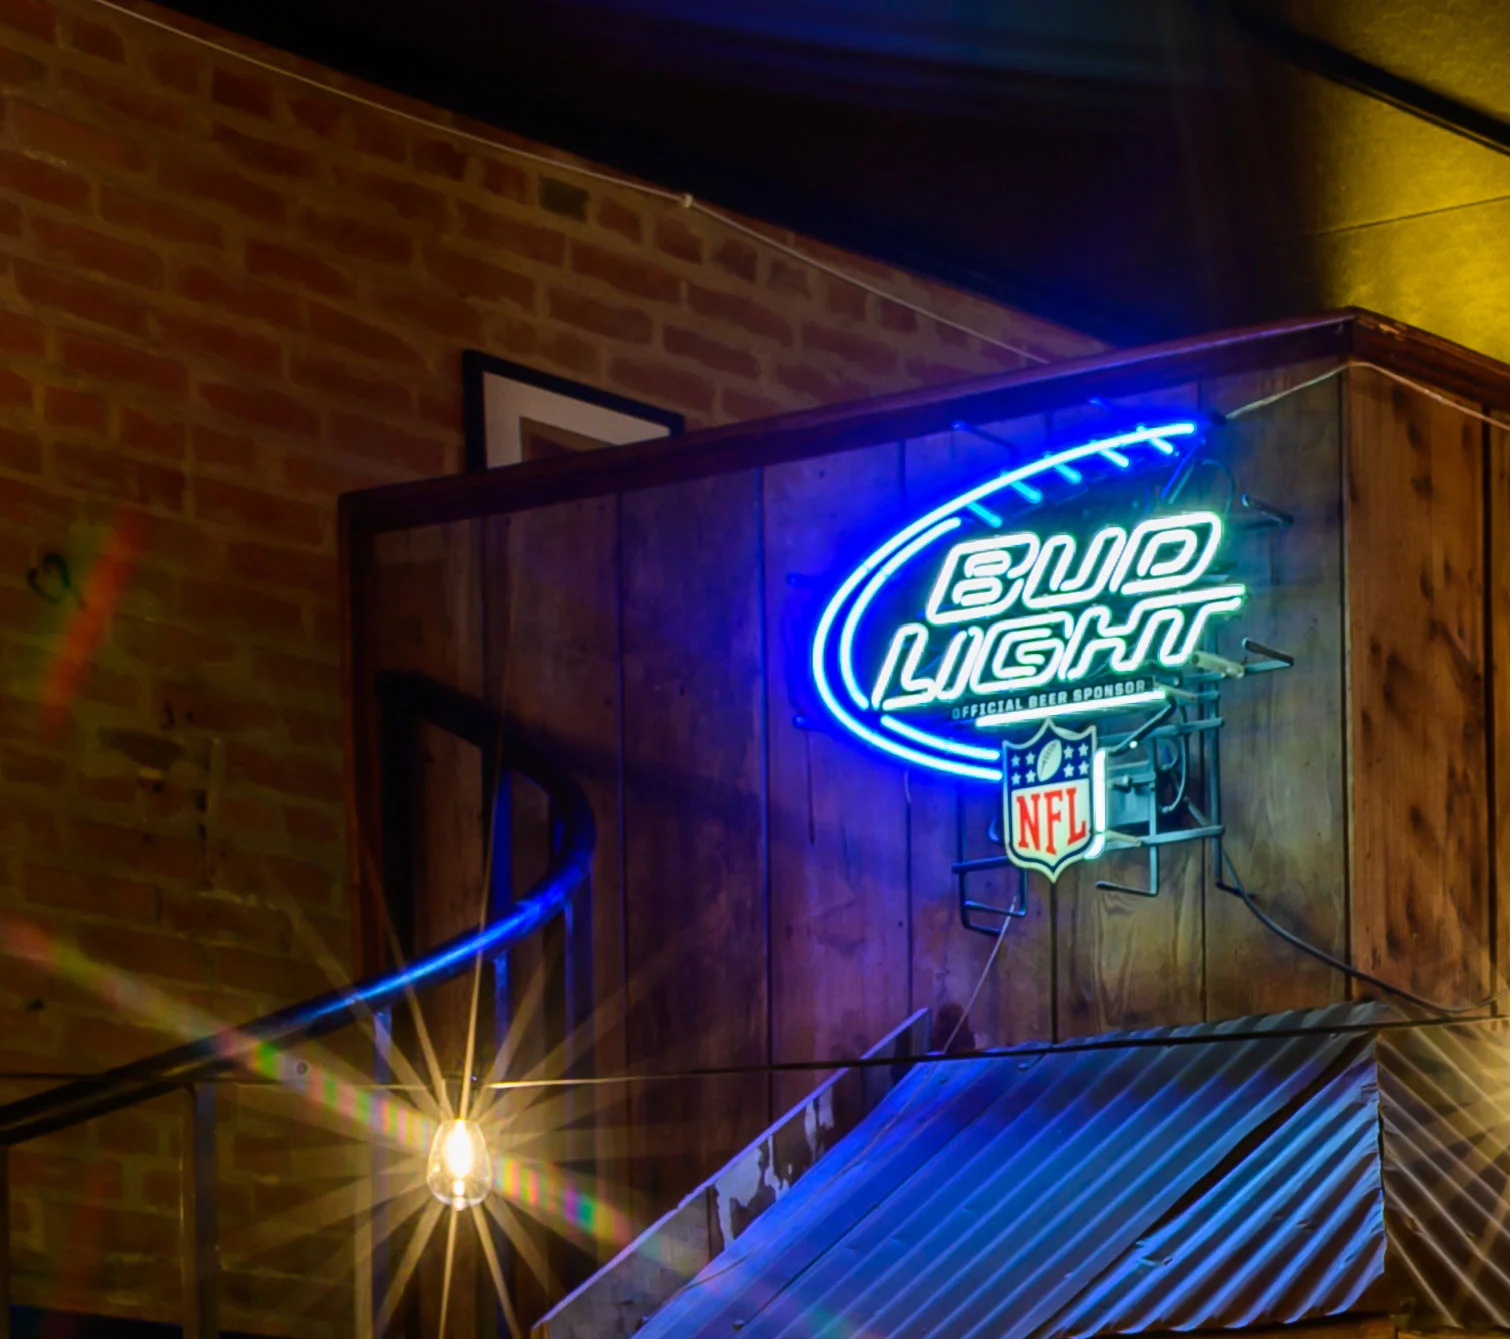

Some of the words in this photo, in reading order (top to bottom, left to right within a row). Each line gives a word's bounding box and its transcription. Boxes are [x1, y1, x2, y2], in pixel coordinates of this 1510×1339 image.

[925, 510, 1223, 626] BUD
[870, 583, 1246, 711] LIGHT
[951, 697, 1023, 720] OFFICIAL
[1028, 690, 1069, 709] BEER
[1072, 679, 1146, 701] SPONSOR
[1015, 787, 1087, 856] NFL
